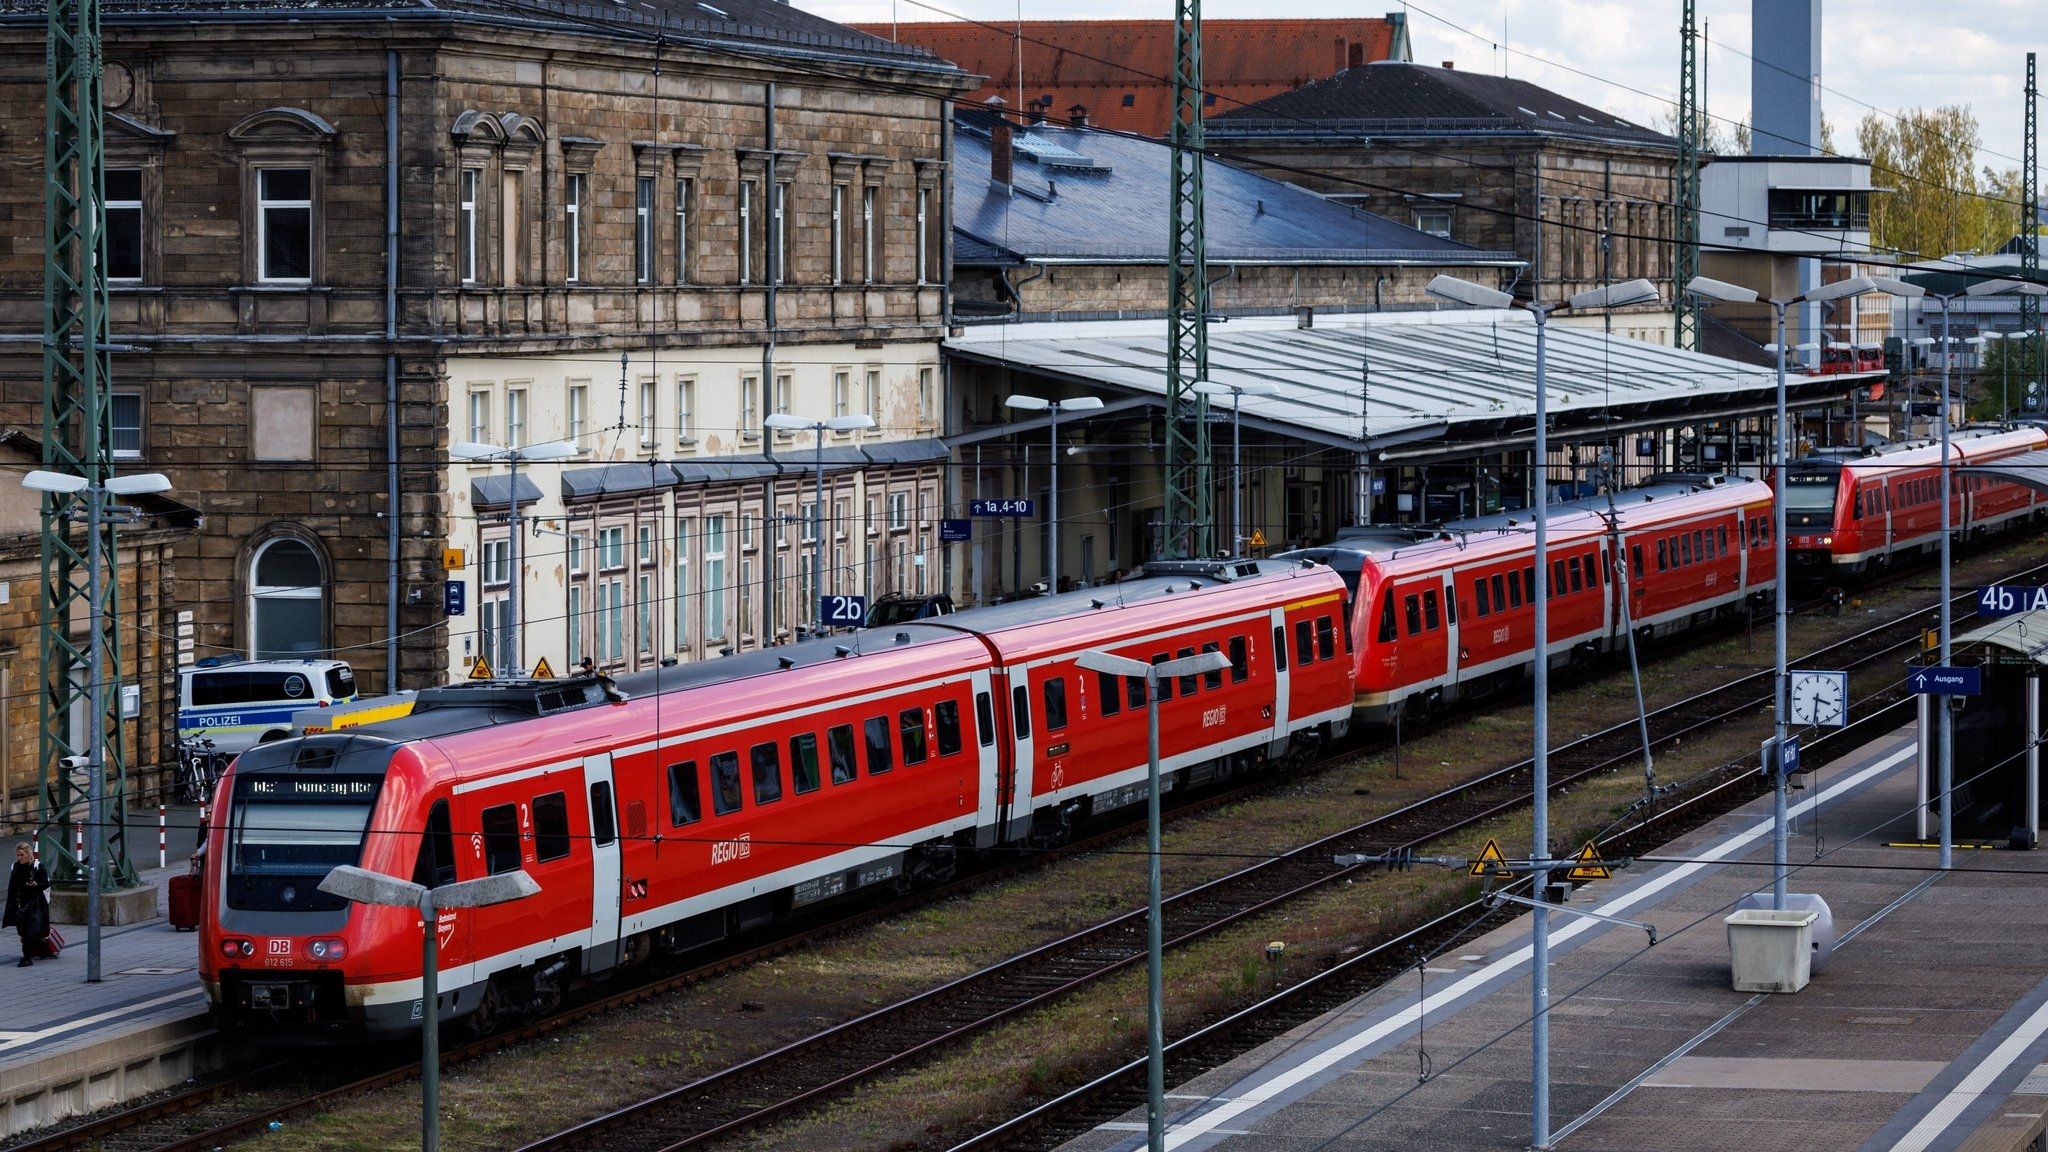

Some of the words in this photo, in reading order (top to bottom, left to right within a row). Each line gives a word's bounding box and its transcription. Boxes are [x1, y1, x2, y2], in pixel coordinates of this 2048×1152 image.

[832, 596, 861, 620] 2b
[1982, 587, 2014, 611] 4b
[1079, 674, 1085, 694] 2
[1934, 675, 1964, 684] Ausgang
[200, 716, 241, 727] POLIZEI
[926, 708, 933, 729] 2
[521, 803, 529, 828] 2
[711, 838, 738, 865] REGIO
[269, 940, 291, 954] DB
[265, 959, 278, 967] 612
[280, 959, 293, 967] 615
